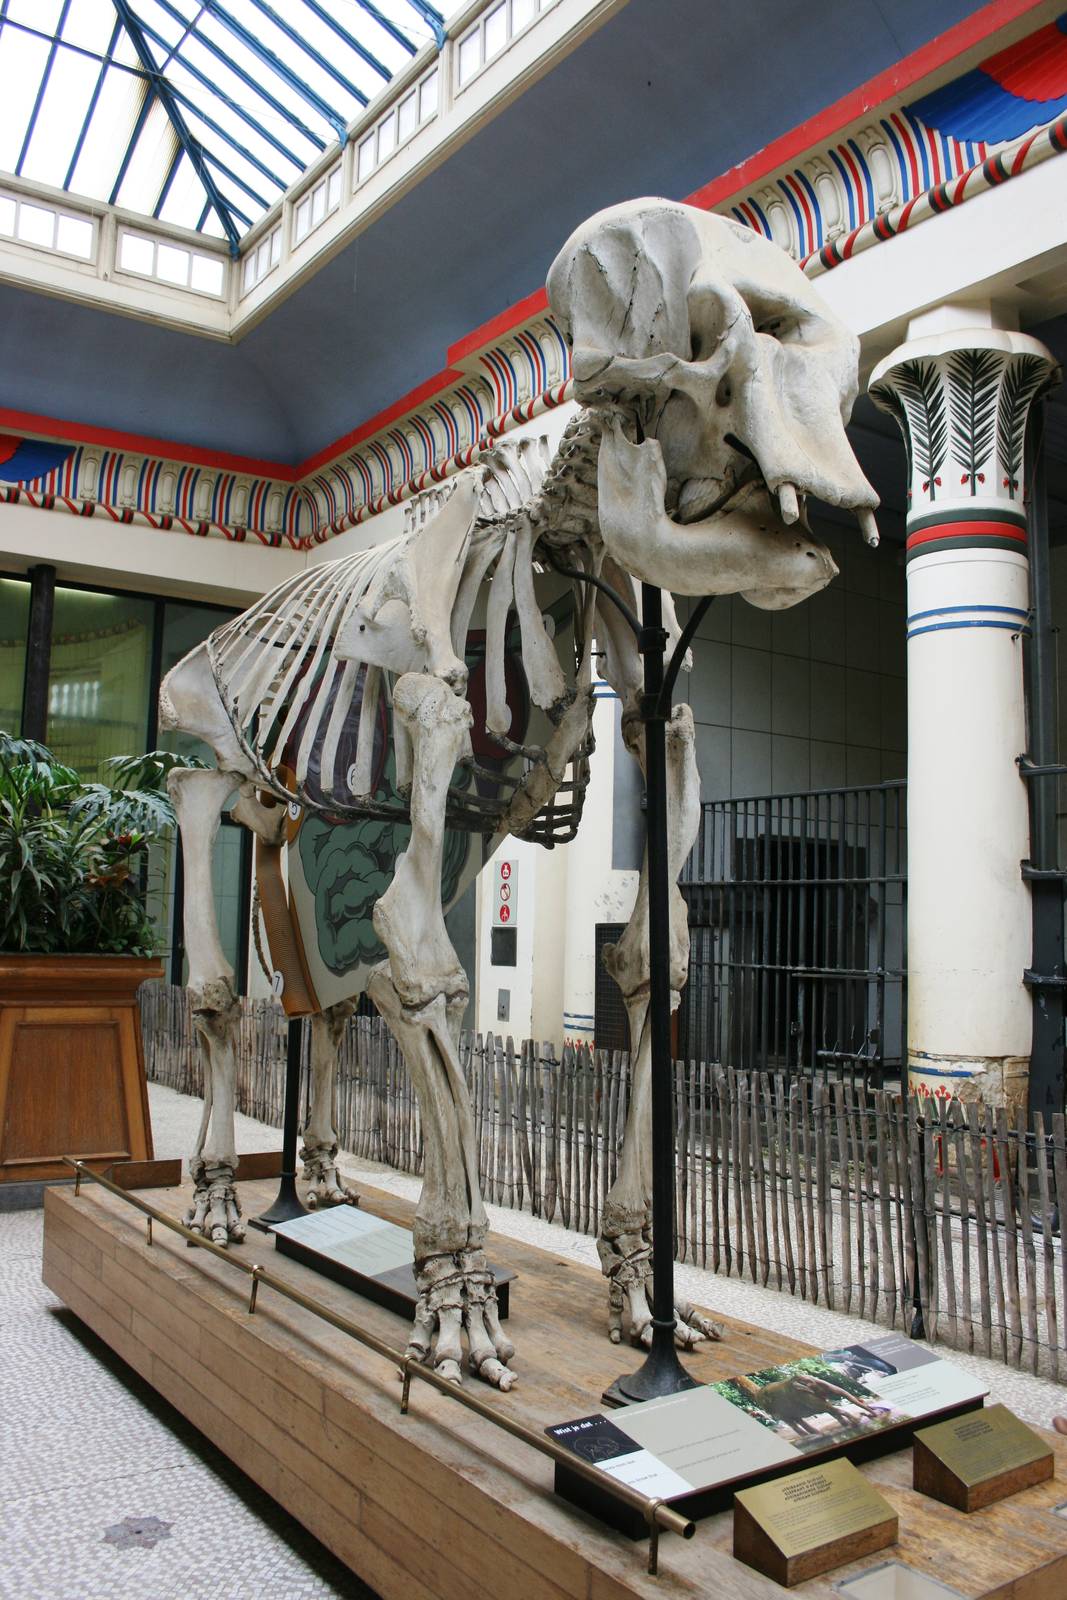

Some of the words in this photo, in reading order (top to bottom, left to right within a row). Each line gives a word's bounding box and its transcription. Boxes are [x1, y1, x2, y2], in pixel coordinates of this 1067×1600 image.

[275, 975, 281, 993] 7
[553, 1427, 572, 1435] Wist
[580, 1421, 593, 1429] dat
